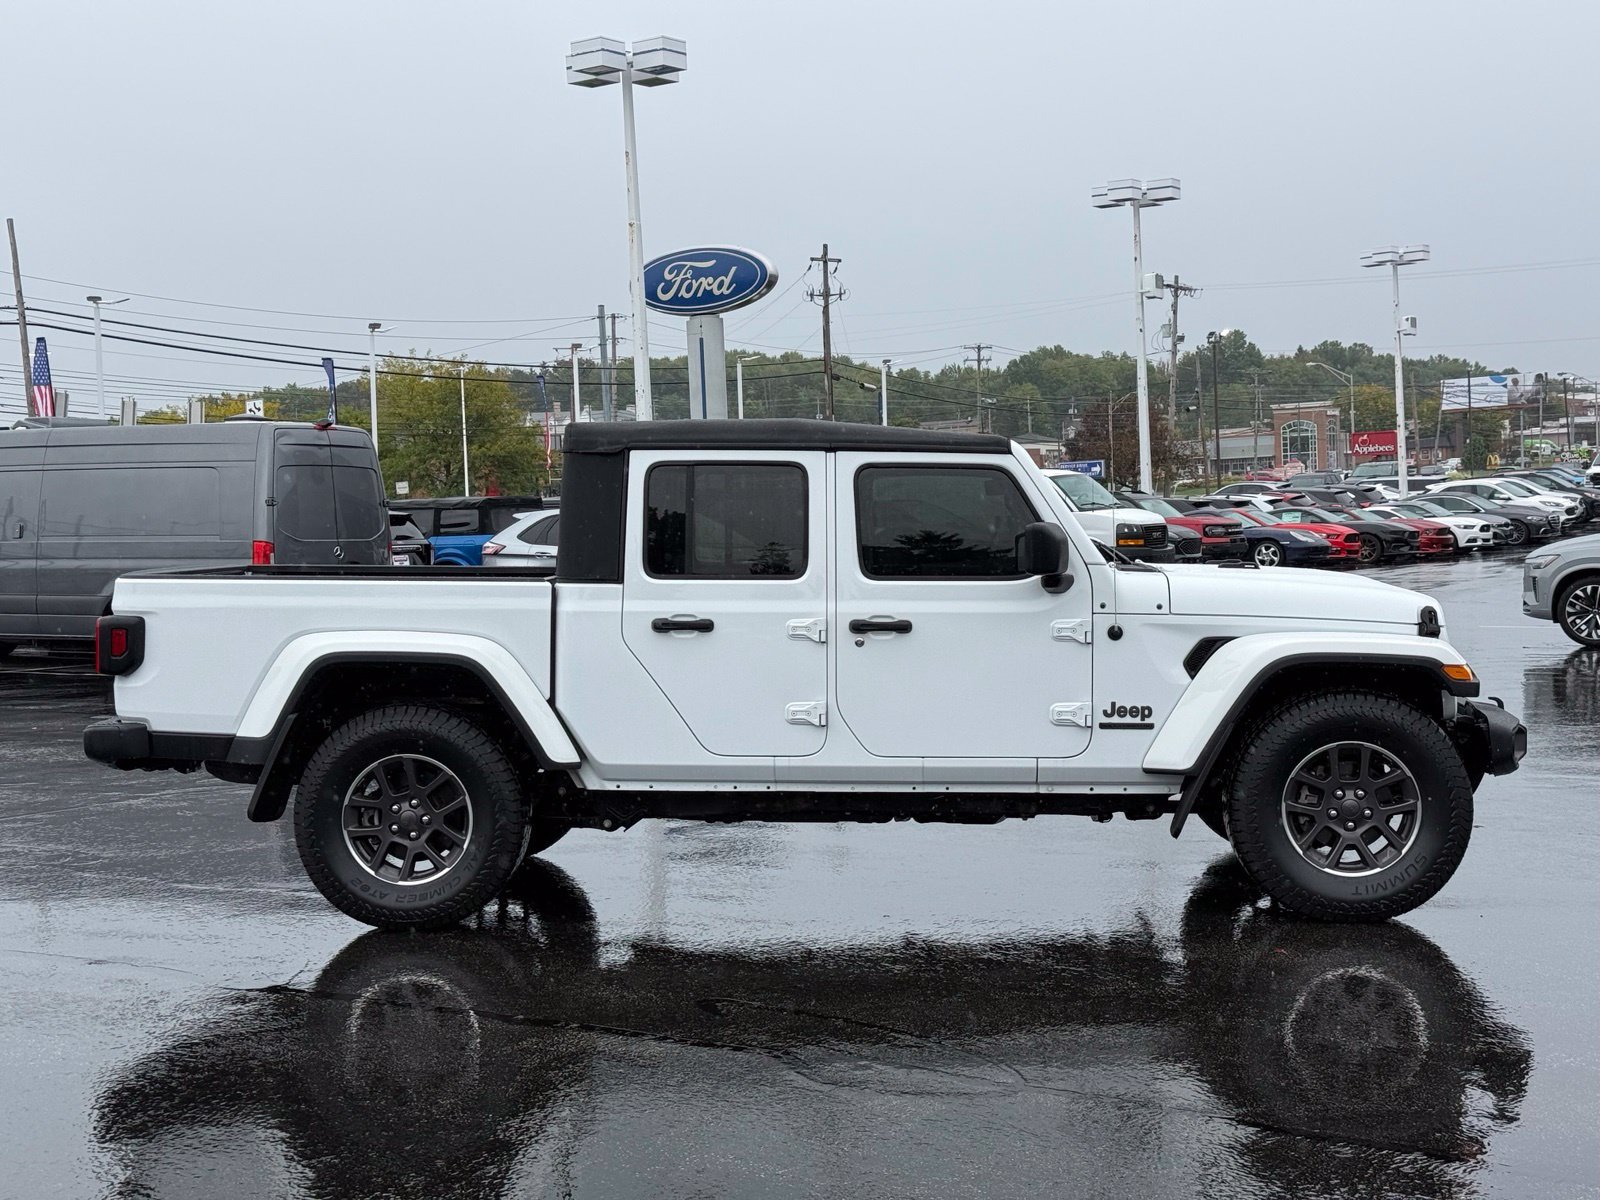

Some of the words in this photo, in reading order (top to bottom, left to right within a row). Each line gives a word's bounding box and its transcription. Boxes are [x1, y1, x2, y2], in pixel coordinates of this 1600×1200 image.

[657, 259, 738, 301] Ford
[1102, 701, 1153, 721] Jeep
[1351, 854, 1428, 896] SUMMIT
